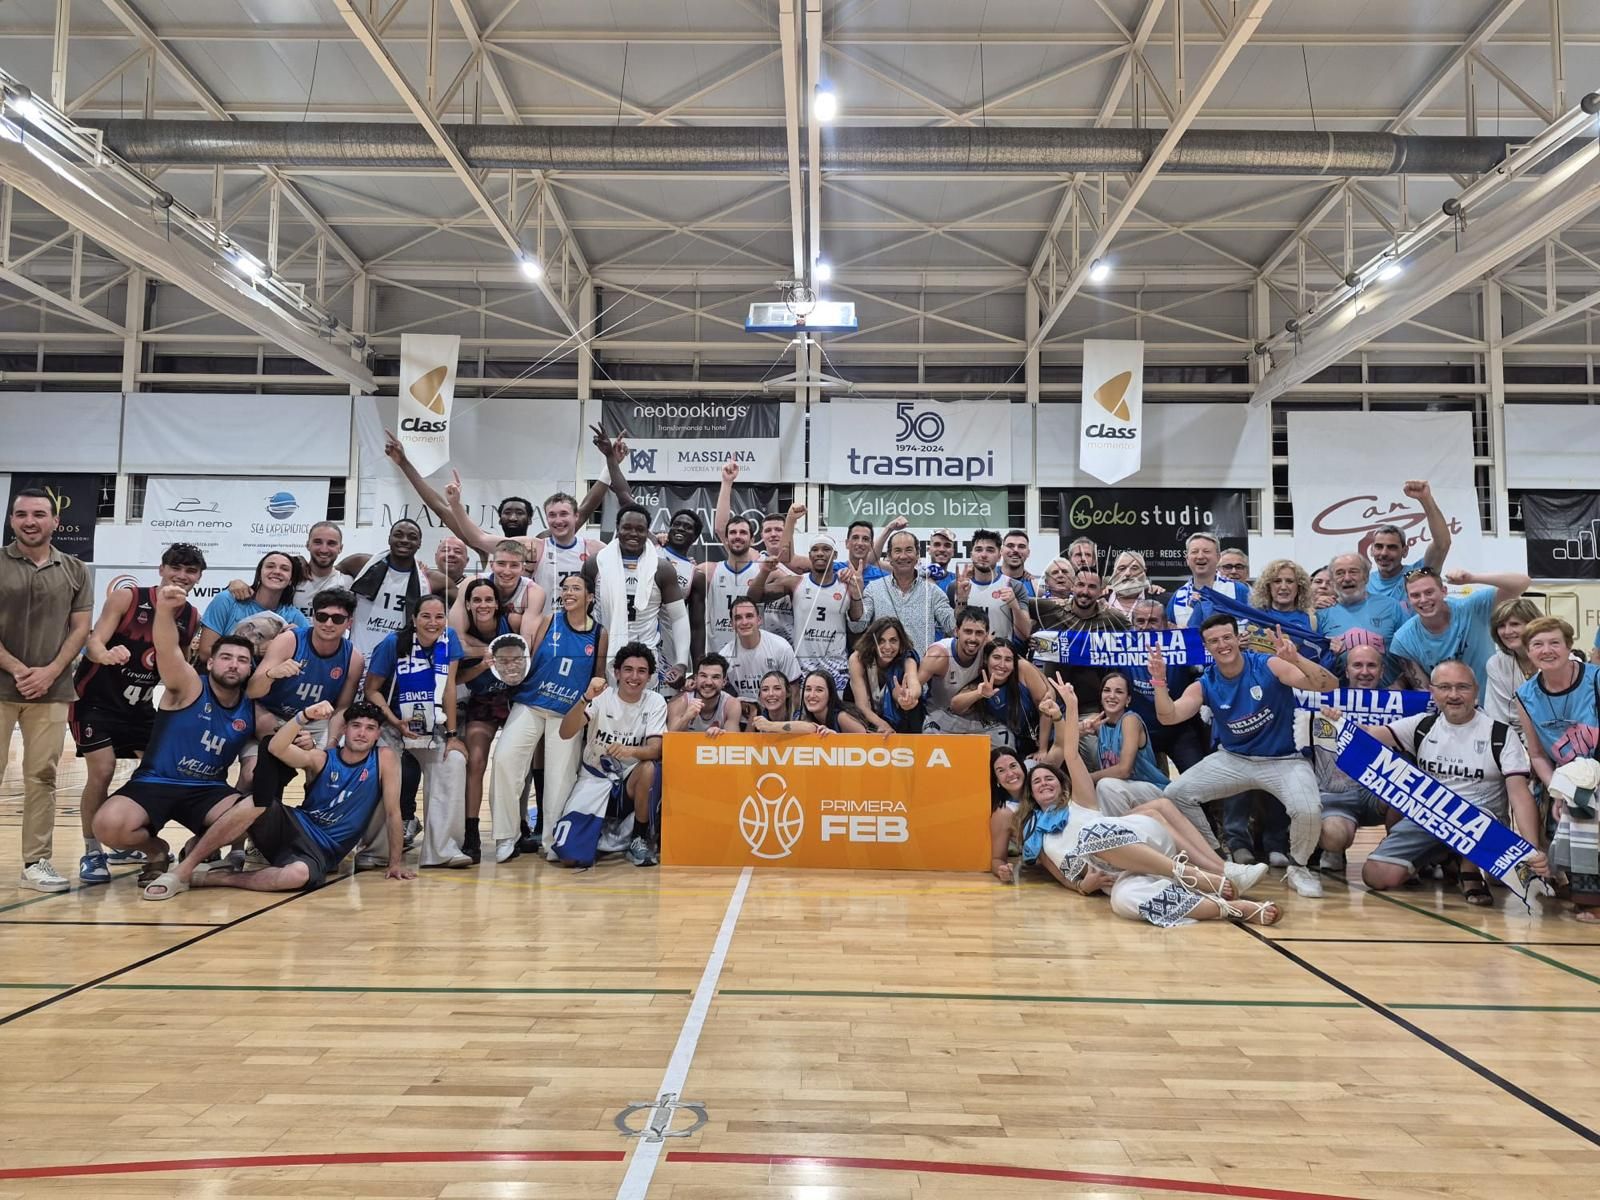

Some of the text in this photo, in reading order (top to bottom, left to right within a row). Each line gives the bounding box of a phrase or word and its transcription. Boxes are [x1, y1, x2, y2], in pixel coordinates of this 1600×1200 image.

[634, 402, 746, 421] neobookings
[401, 417, 447, 432] Class
[711, 424, 727, 432] hotel
[896, 402, 945, 443] 50
[1085, 422, 1136, 439] Class
[678, 451, 755, 462] MASSIANA
[847, 448, 993, 481] trasmapi
[848, 497, 992, 517] Vallados Ibiza
[1069, 495, 1213, 529] Gecko studio
[150, 518, 233, 532] capitán nemo
[251, 523, 264, 534] SEA
[1160, 549, 1182, 558] REDES
[383, 593, 406, 612] 13
[816, 607, 826, 621] 3
[1091, 630, 1187, 652] MELILLA
[558, 657, 573, 677] 0
[1090, 650, 1187, 666] BALONCSTO
[296, 683, 324, 702] 44
[405, 691, 428, 701] CMB
[538, 681, 580, 701] MELILLA
[1292, 688, 1404, 714] MELILLA
[1227, 708, 1271, 729] MELILLA
[1231, 713, 1274, 735] BALONCESTO
[200, 730, 226, 755] 44
[998, 731, 1009, 744] 7
[696, 745, 951, 767] BIENVENIDOS A
[1436, 755, 1464, 764] CLUB
[1418, 758, 1484, 779] MELILLA
[1368, 745, 1492, 841] MELILLA
[821, 799, 907, 813] PRIMERA
[1357, 767, 1478, 855] BALONCESTO
[821, 815, 909, 843] FEB
[1495, 846, 1522, 871] CMB
